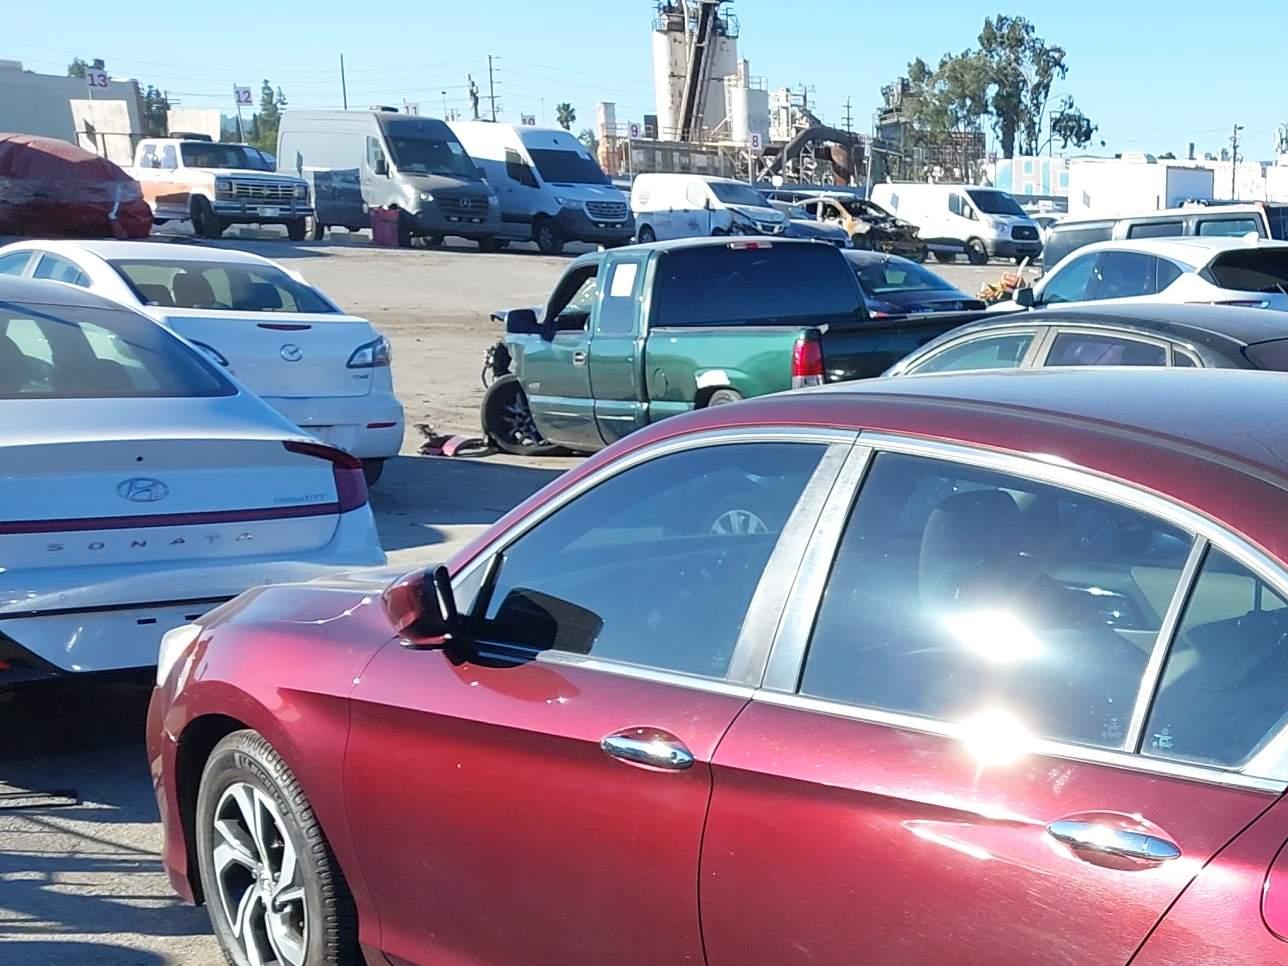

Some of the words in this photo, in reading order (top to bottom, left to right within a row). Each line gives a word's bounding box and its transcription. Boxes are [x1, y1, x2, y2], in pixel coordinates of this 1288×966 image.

[88, 73, 108, 87] 13
[235, 90, 251, 103] 12
[630, 124, 638, 137] 9
[751, 135, 759, 148] 8
[46, 532, 253, 552] SONATA
